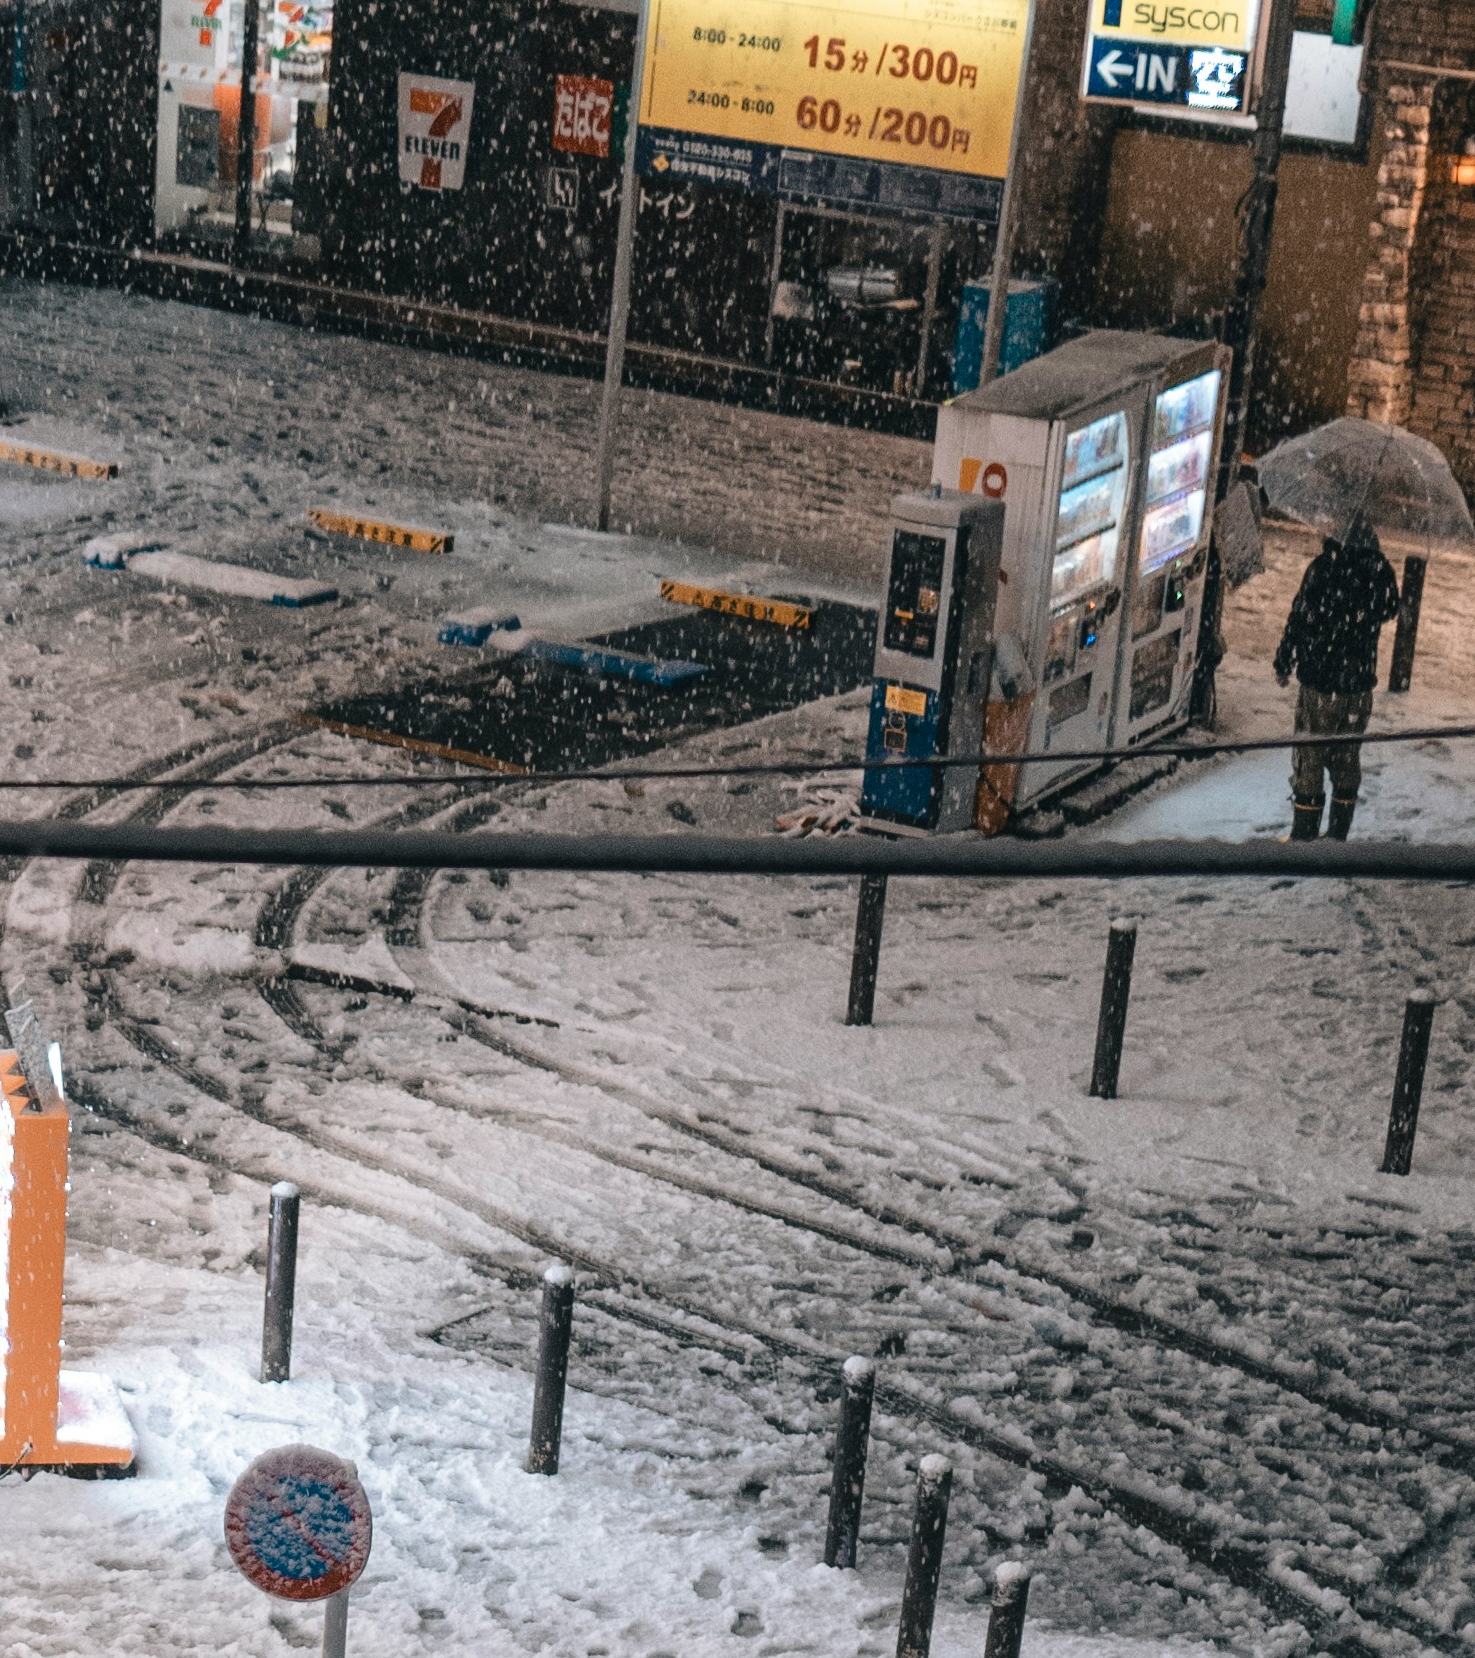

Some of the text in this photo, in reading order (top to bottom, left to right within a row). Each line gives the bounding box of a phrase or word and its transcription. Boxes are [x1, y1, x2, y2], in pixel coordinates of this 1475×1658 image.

[1134, 3, 1239, 33] syscon
[1135, 53, 1178, 94] IN
[554, 90, 612, 144] たばこ
[599, 178, 696, 218] イトイン
